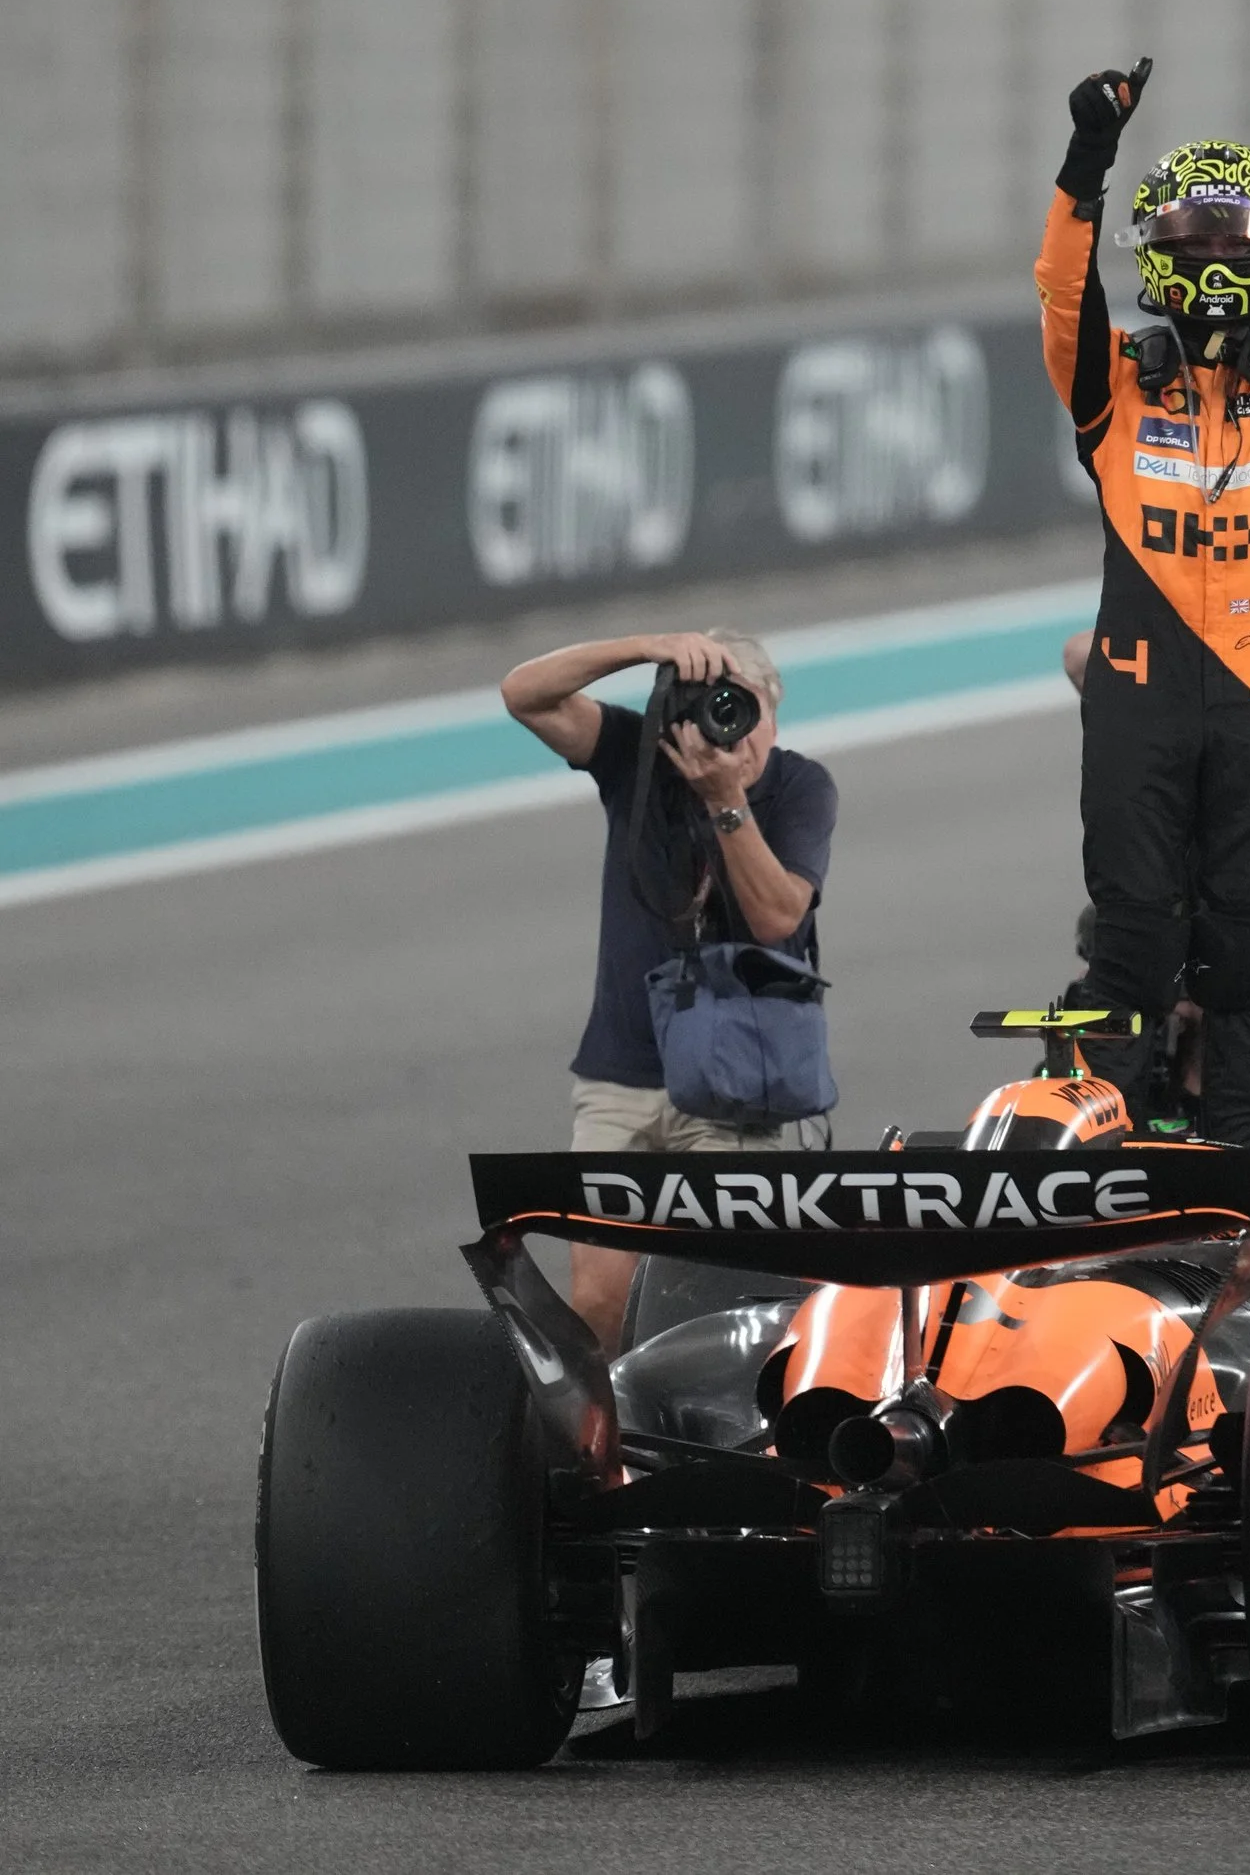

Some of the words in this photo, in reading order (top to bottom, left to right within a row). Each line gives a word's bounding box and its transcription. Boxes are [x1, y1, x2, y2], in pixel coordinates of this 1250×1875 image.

[1214, 197, 1241, 205] WORLD
[1199, 294, 1234, 304] Android
[1146, 435, 1159, 443] DP
[1159, 436, 1190, 448] WORLD
[1136, 456, 1180, 477] DELL
[27, 399, 370, 641] ETIHAD
[580, 1169, 1152, 1230] DARKTRACE
[1190, 1392, 1216, 1422] ence
